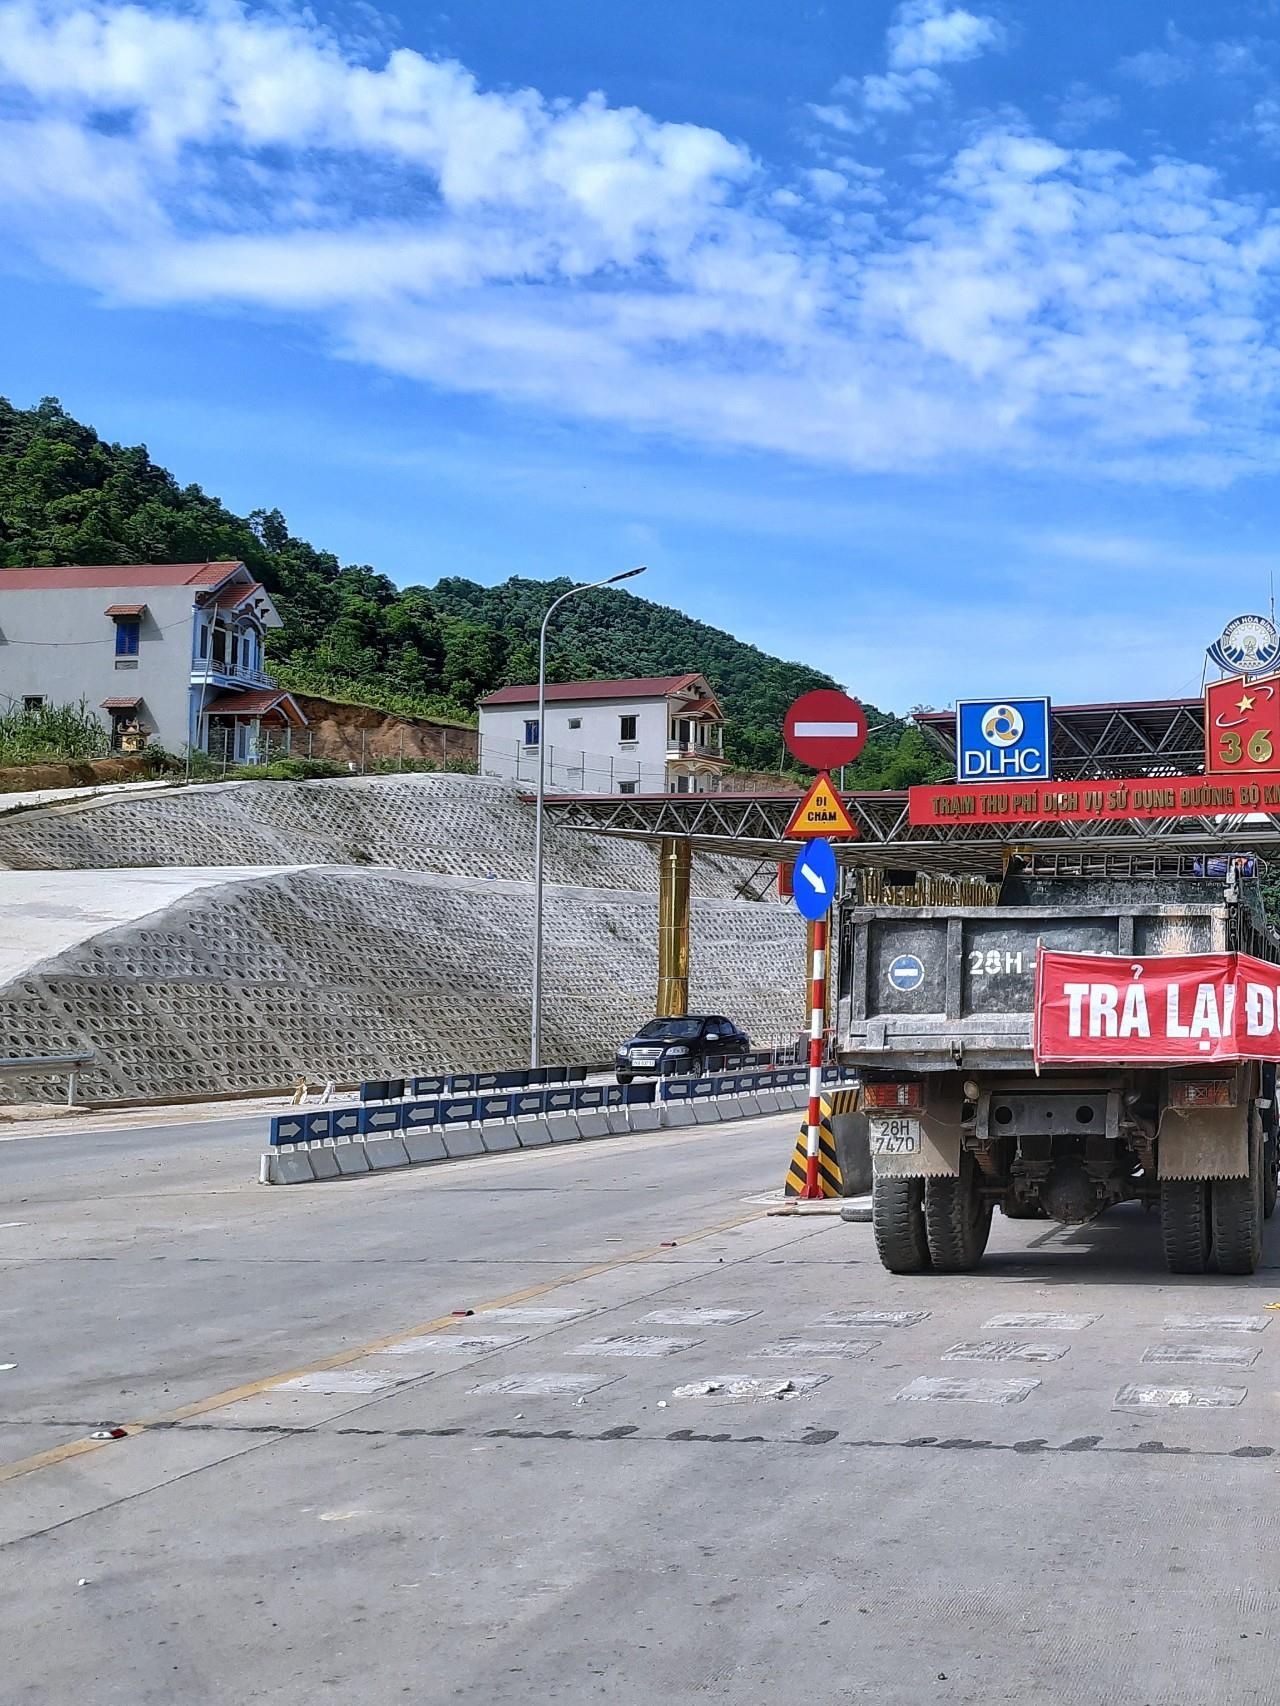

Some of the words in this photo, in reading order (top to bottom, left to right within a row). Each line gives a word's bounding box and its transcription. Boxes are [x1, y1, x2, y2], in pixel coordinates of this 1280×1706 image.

[1219, 730, 1272, 763] 36
[965, 748, 1041, 775] DLHC
[816, 796, 827, 807] ĐI
[932, 796, 976, 819] TRẠM
[980, 794, 1009, 813] THU
[1013, 788, 1038, 812] PHÍ
[1043, 792, 1078, 815] DỊCH
[1084, 791, 1103, 815] VỤ
[1107, 782, 1128, 809] SỬ
[1133, 788, 1175, 813] DỤNG
[1180, 781, 1234, 807] ĐƯỜNG
[1240, 782, 1260, 809] BỘ
[807, 809, 837, 824] CHẬM
[968, 950, 1022, 975] 28H
[1063, 964, 1151, 1038] TRẢ
[1166, 983, 1236, 1051] LẠI
[881, 1120, 909, 1137] 28H
[876, 1136, 915, 1154] 7470
